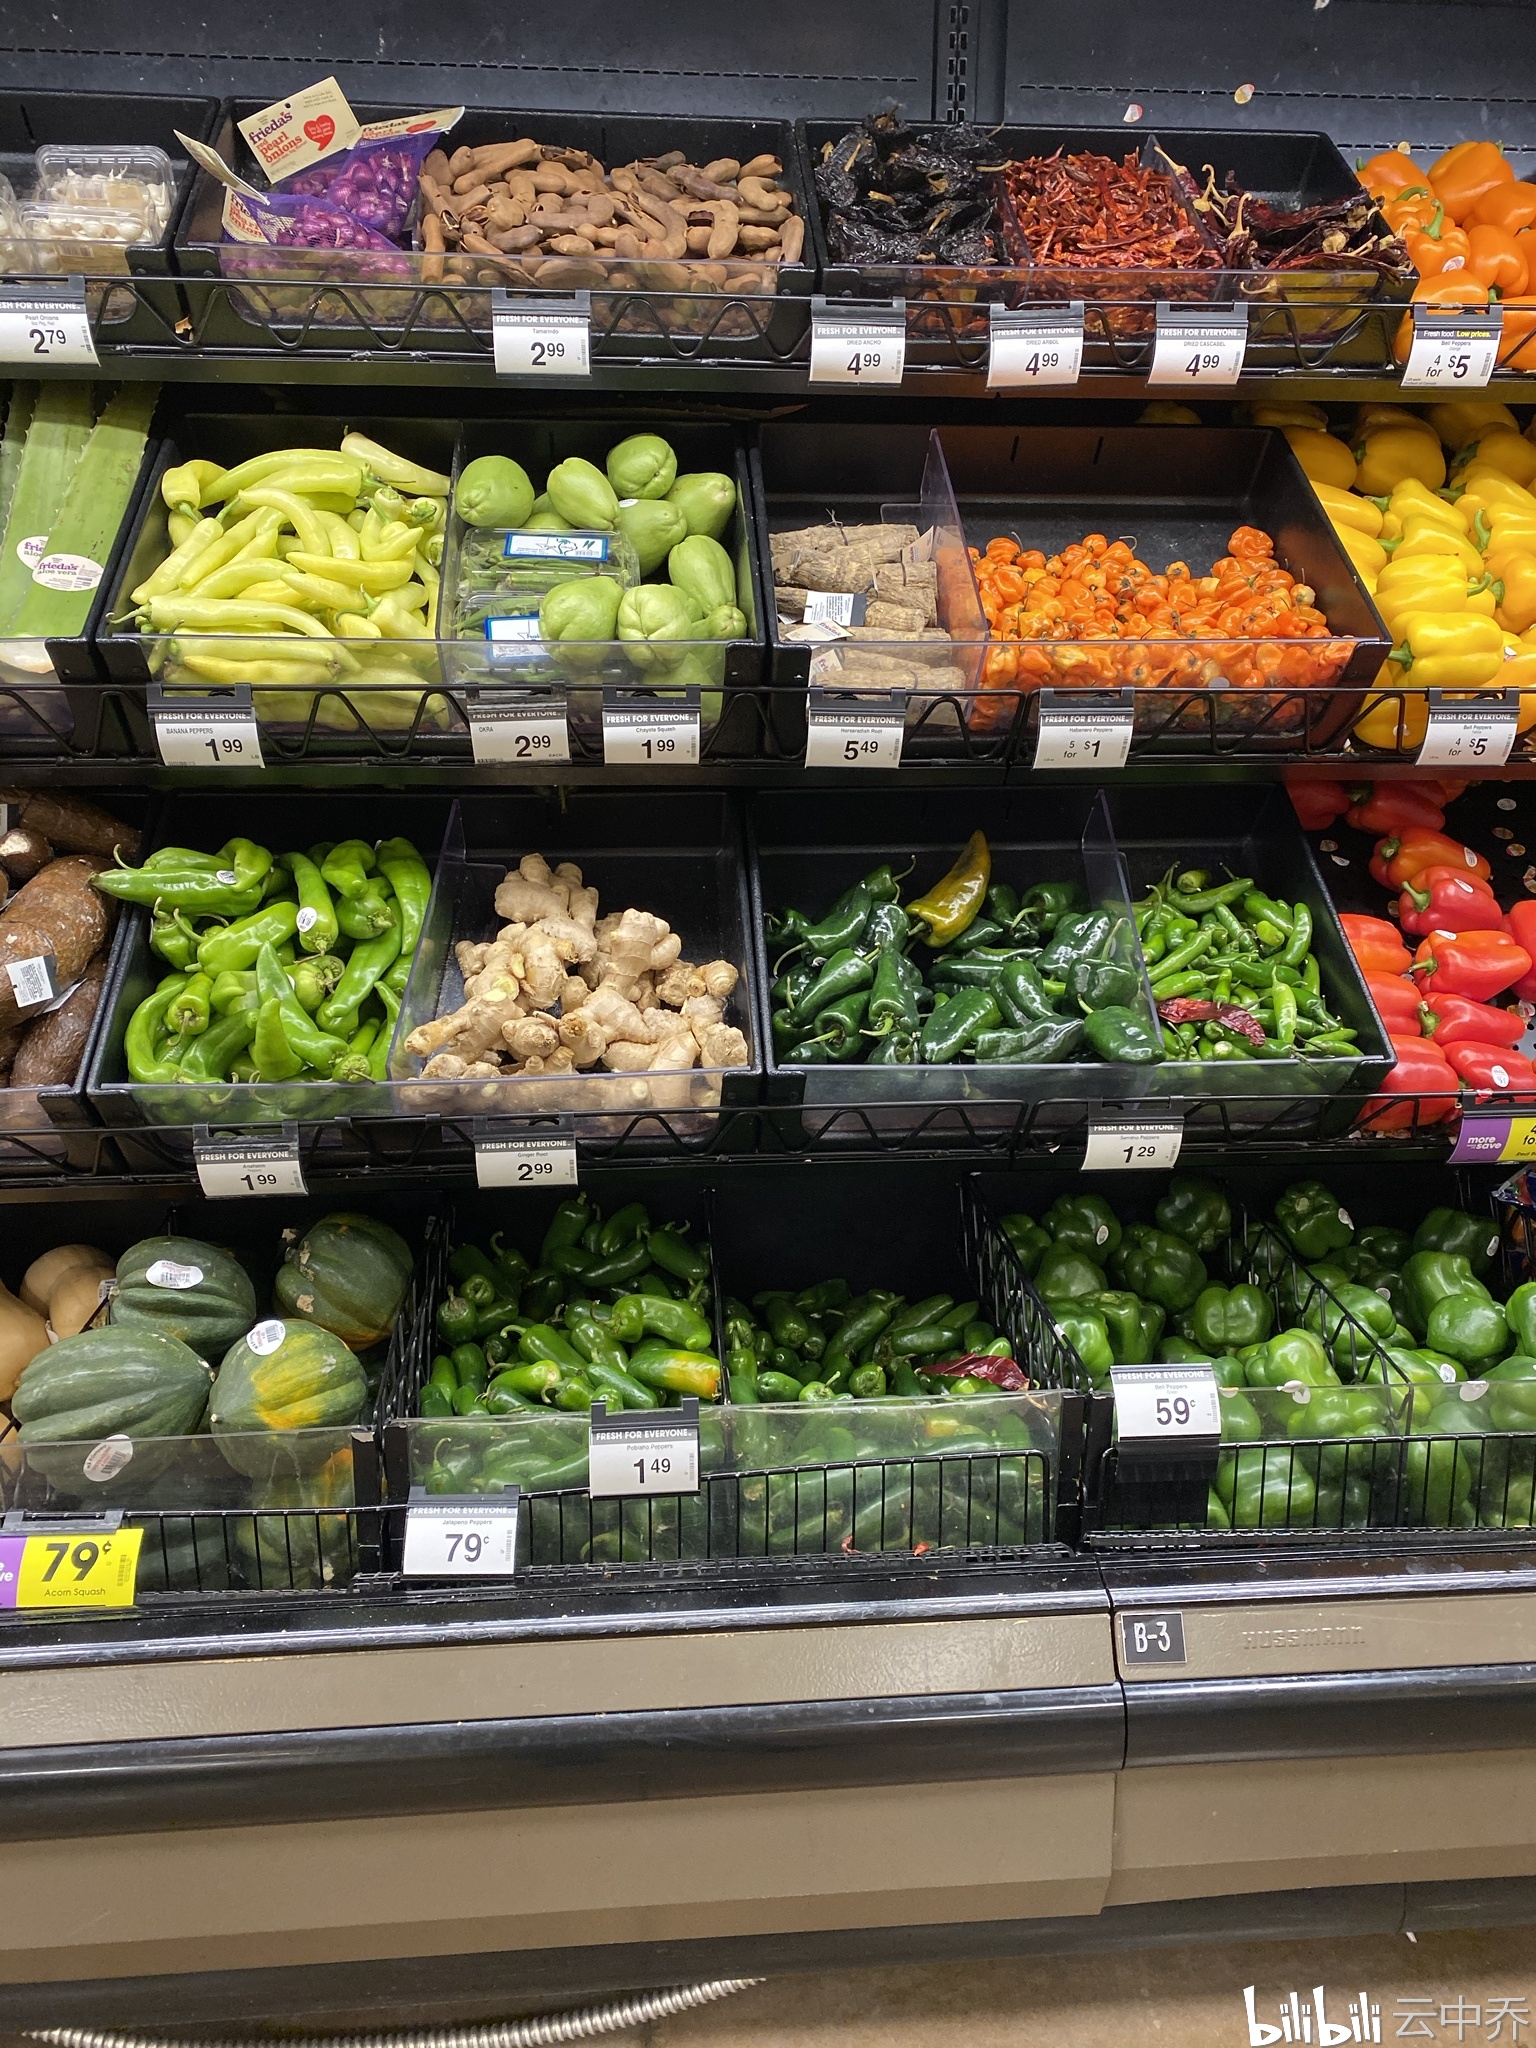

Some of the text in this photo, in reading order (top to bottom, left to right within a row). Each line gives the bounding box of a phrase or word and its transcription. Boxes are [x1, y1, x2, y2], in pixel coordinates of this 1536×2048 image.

[256, 139, 268, 149] red
[260, 131, 289, 158] pearl
[265, 136, 302, 163] onions
[496, 315, 520, 323] FRESH
[817, 327, 840, 335] FRESH
[842, 327, 857, 335] FOR
[1433, 355, 1441, 366] 4
[1426, 367, 1443, 377] for
[606, 716, 630, 724] FRESH
[632, 715, 648, 723] FOR
[814, 715, 838, 723] FRESH
[1455, 738, 1462, 746] 4
[1448, 748, 1462, 756] for
[1467, 1136, 1496, 1144] more
[201, 1153, 226, 1161] FRESH
[596, 1432, 622, 1441] FRESH
[624, 1431, 642, 1439] FOR
[44, 1588, 106, 1597] Acorn Squash
[1133, 1621, 1171, 1653] B-3
